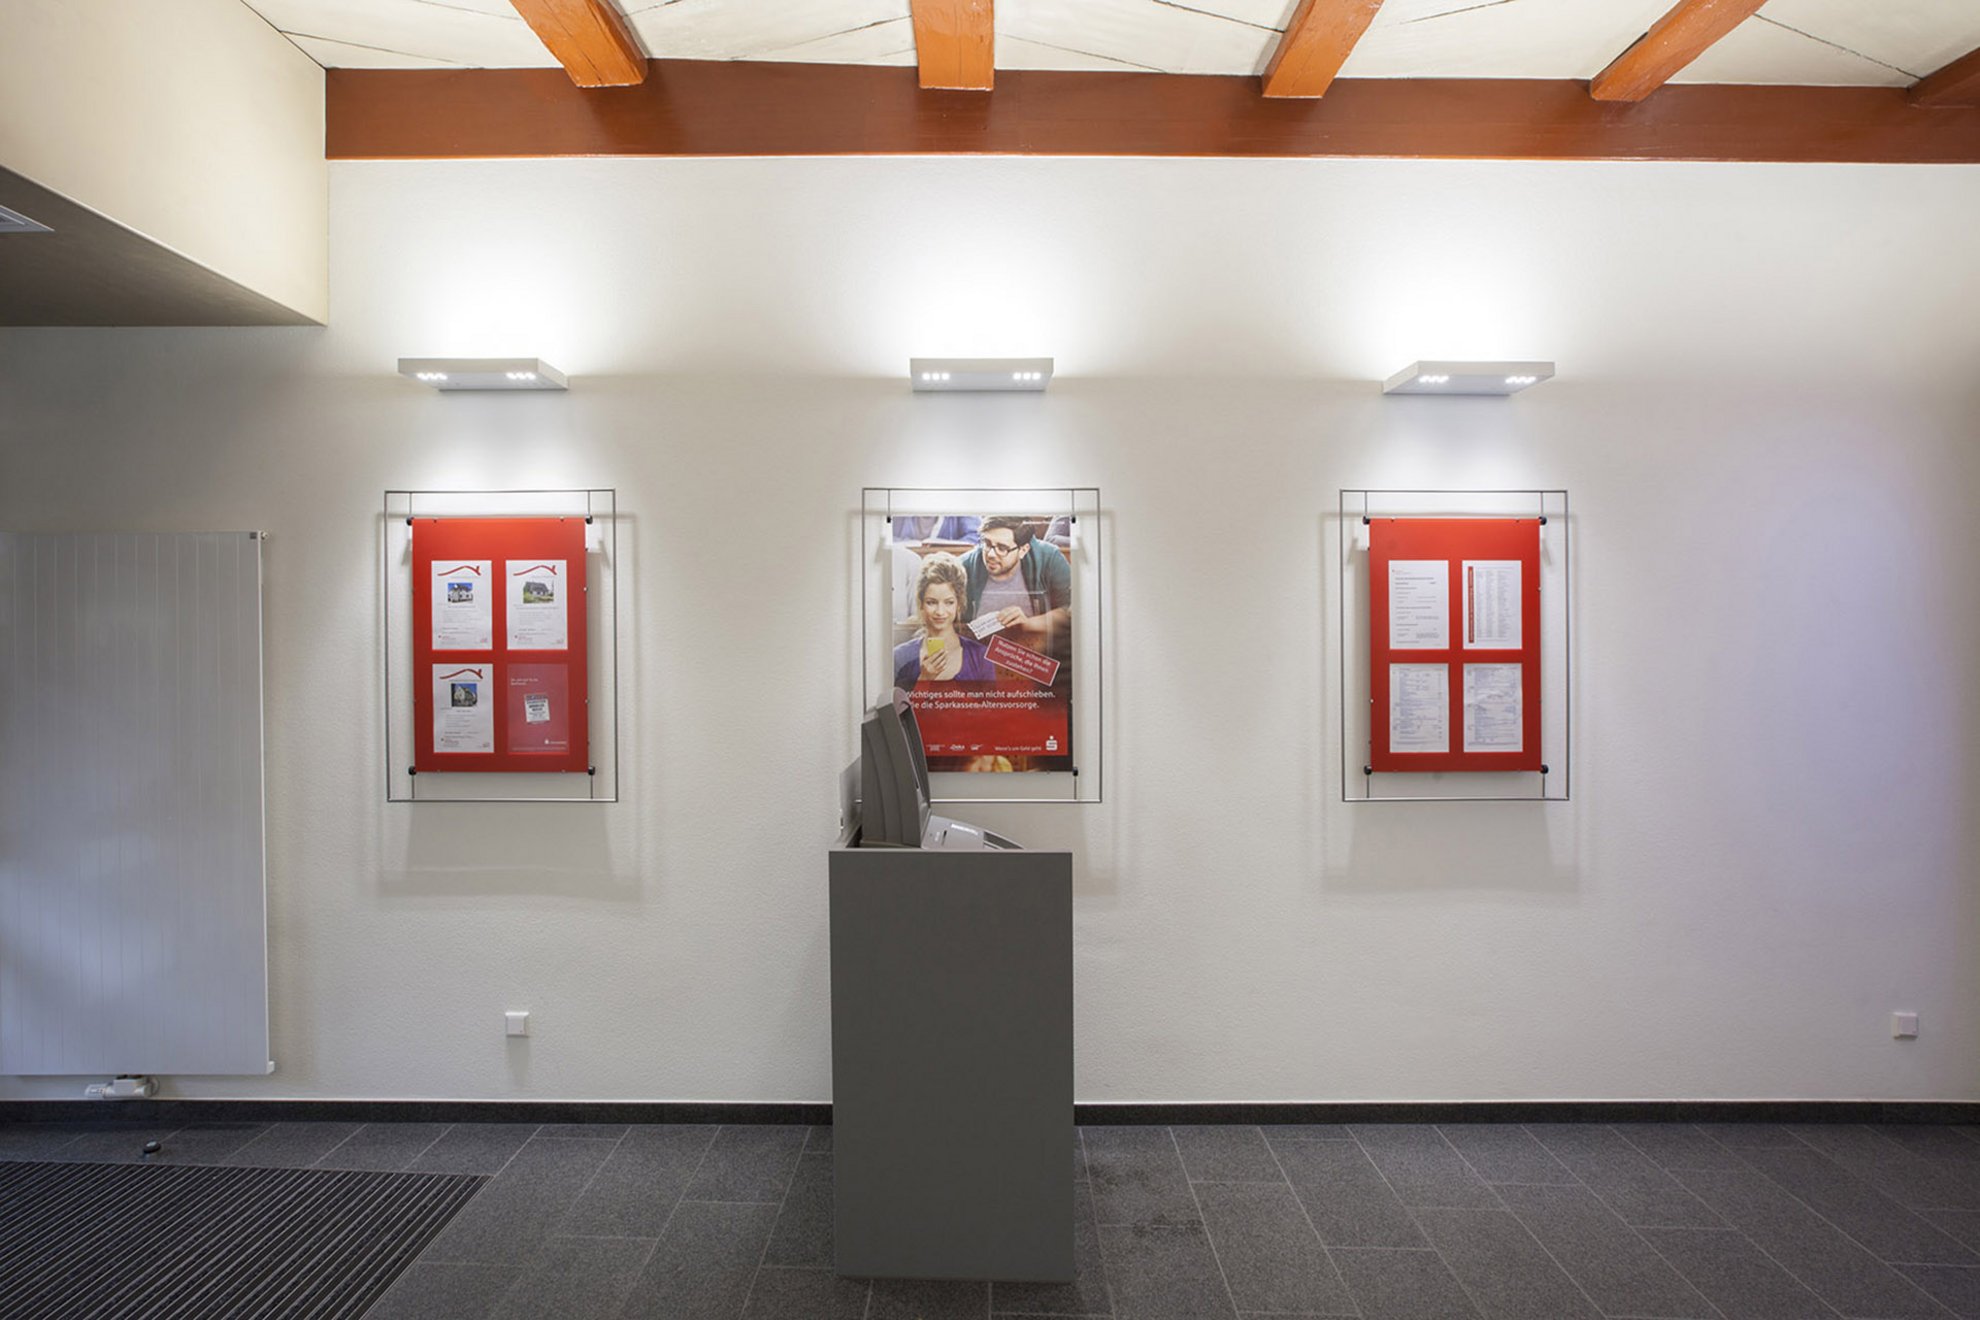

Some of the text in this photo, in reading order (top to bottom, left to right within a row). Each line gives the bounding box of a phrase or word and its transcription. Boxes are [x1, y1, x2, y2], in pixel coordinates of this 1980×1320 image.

[944, 690, 966, 699] sollte
[966, 691, 985, 699] man
[985, 690, 1006, 699] nicht
[1006, 690, 1056, 699] aufschieben.
[920, 701, 934, 709] die
[934, 701, 1039, 710] Sparkassen-Altersvorsorge.
